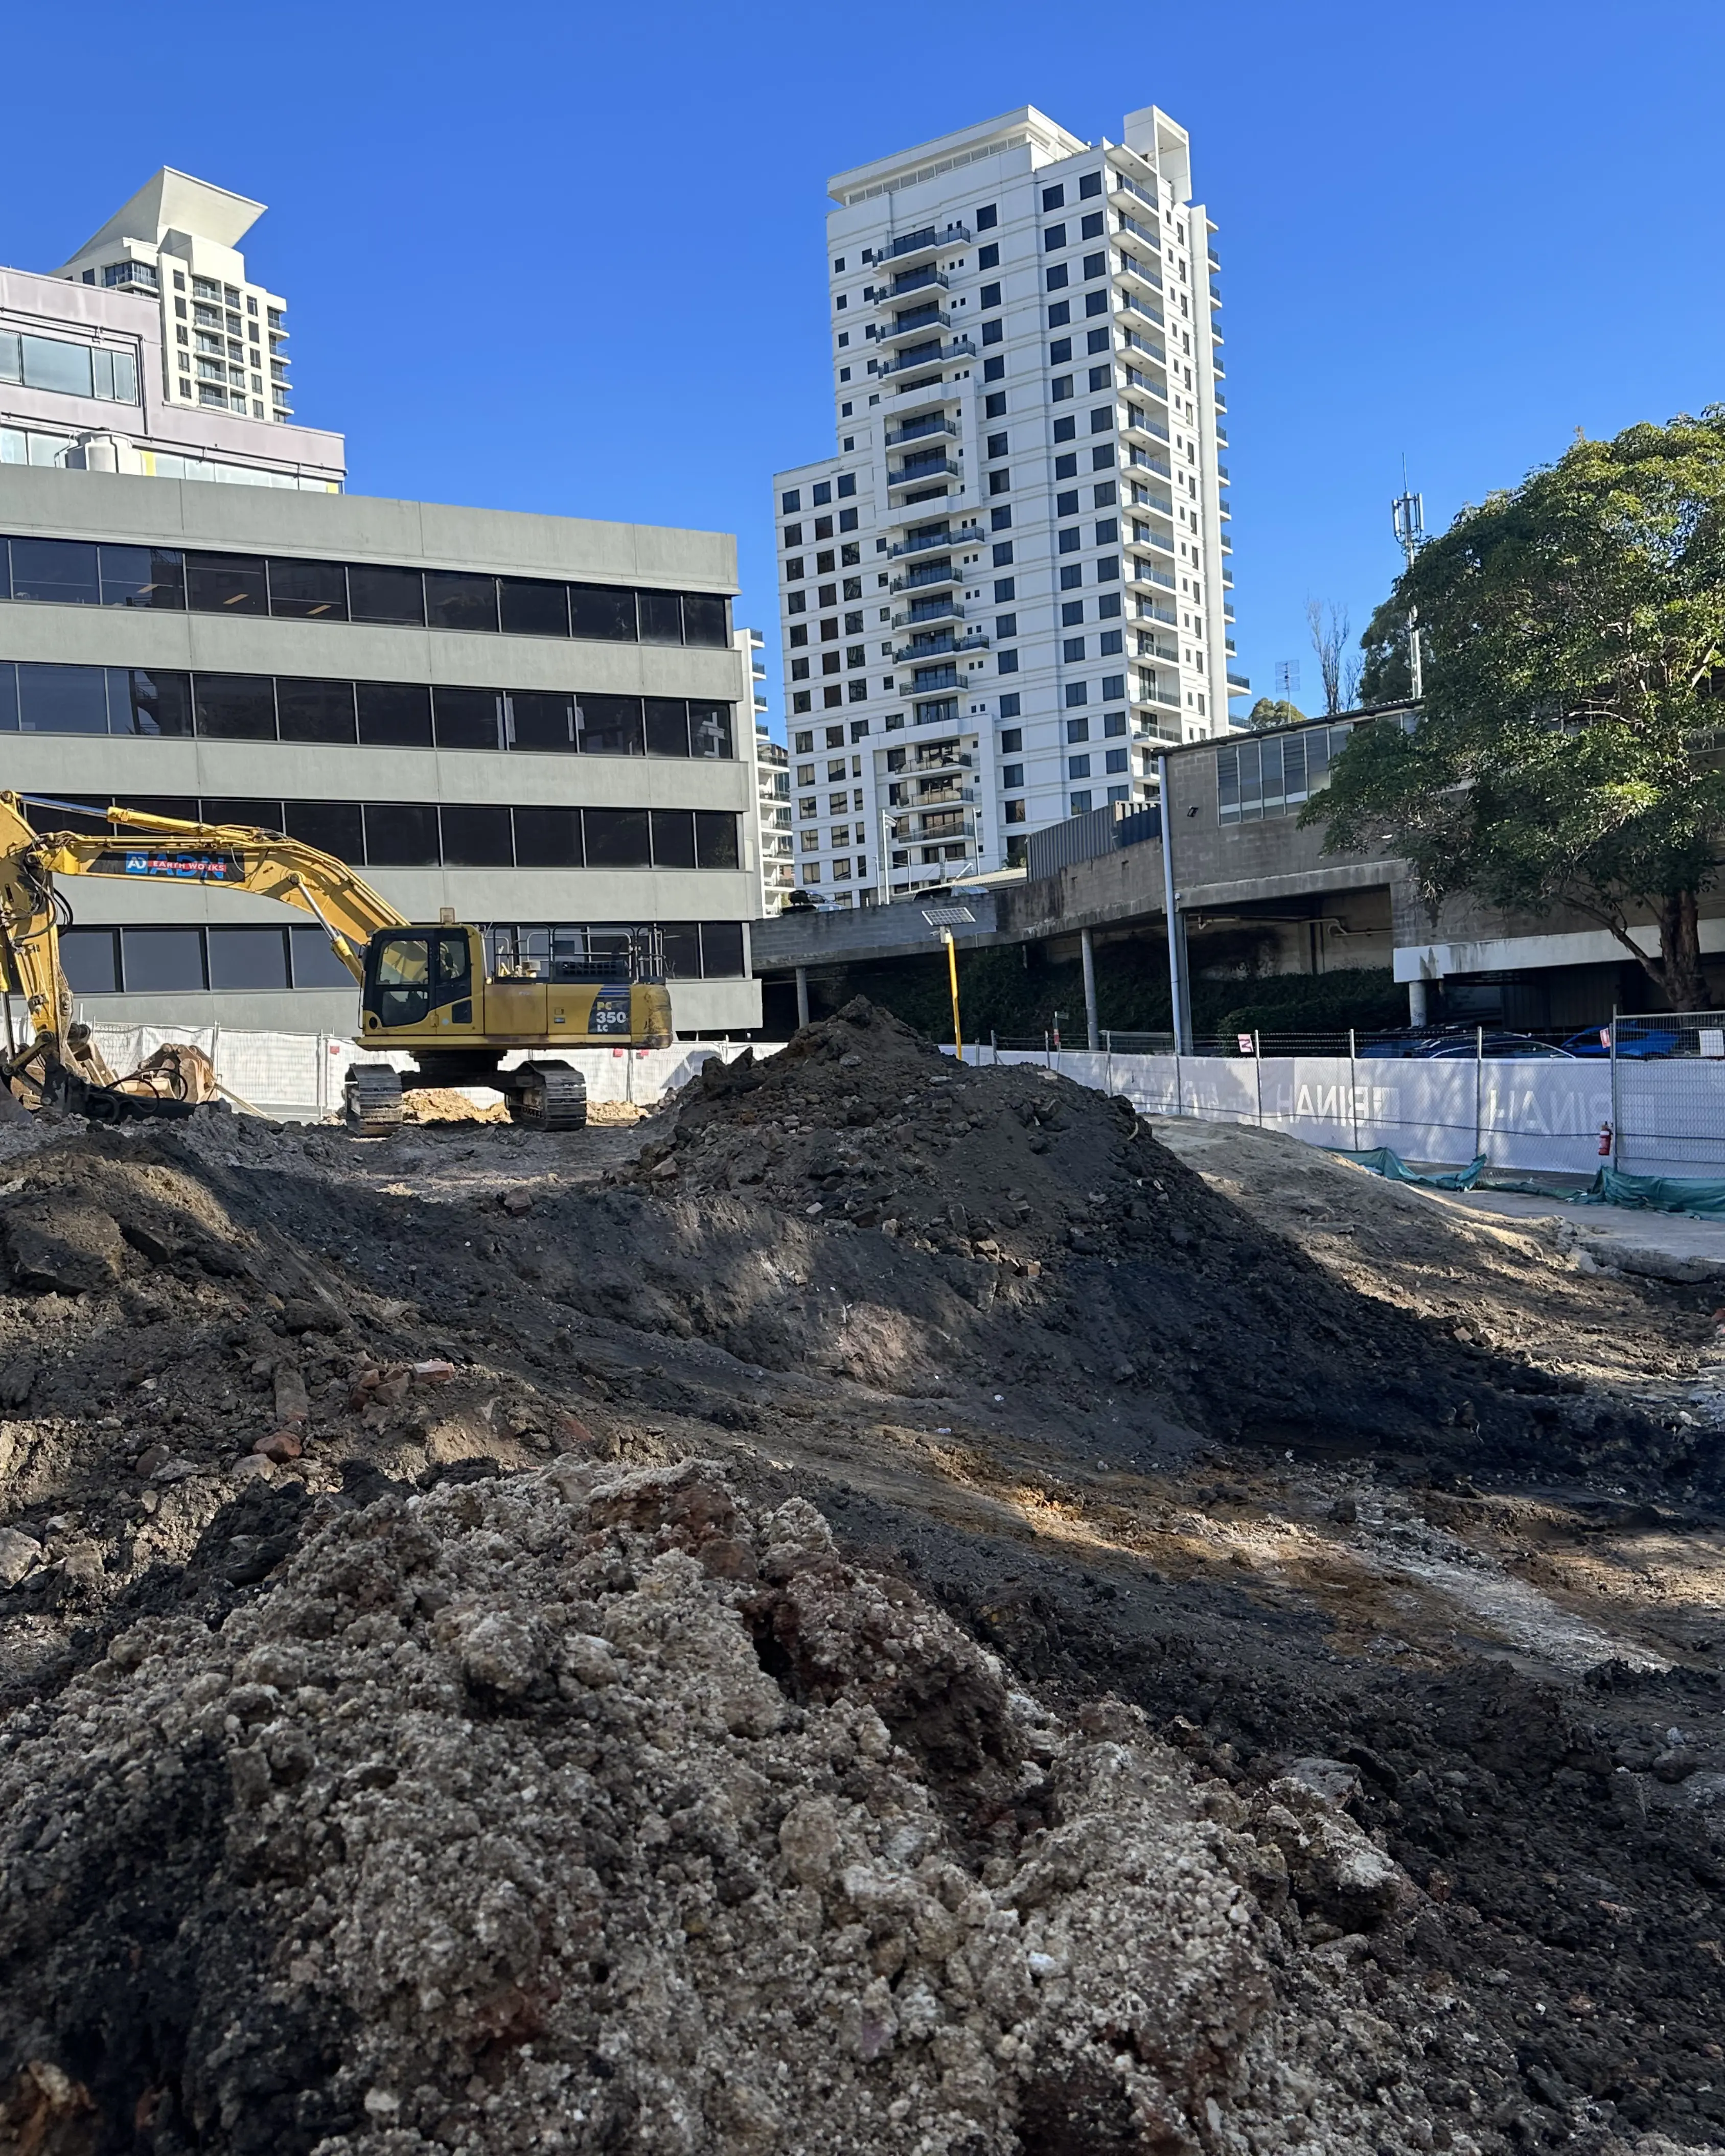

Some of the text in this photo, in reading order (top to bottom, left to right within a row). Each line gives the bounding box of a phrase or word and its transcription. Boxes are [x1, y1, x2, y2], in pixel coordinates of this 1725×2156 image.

[153, 861, 185, 869] EARTH
[597, 1002, 612, 1010] PC
[596, 1012, 626, 1024] 350
